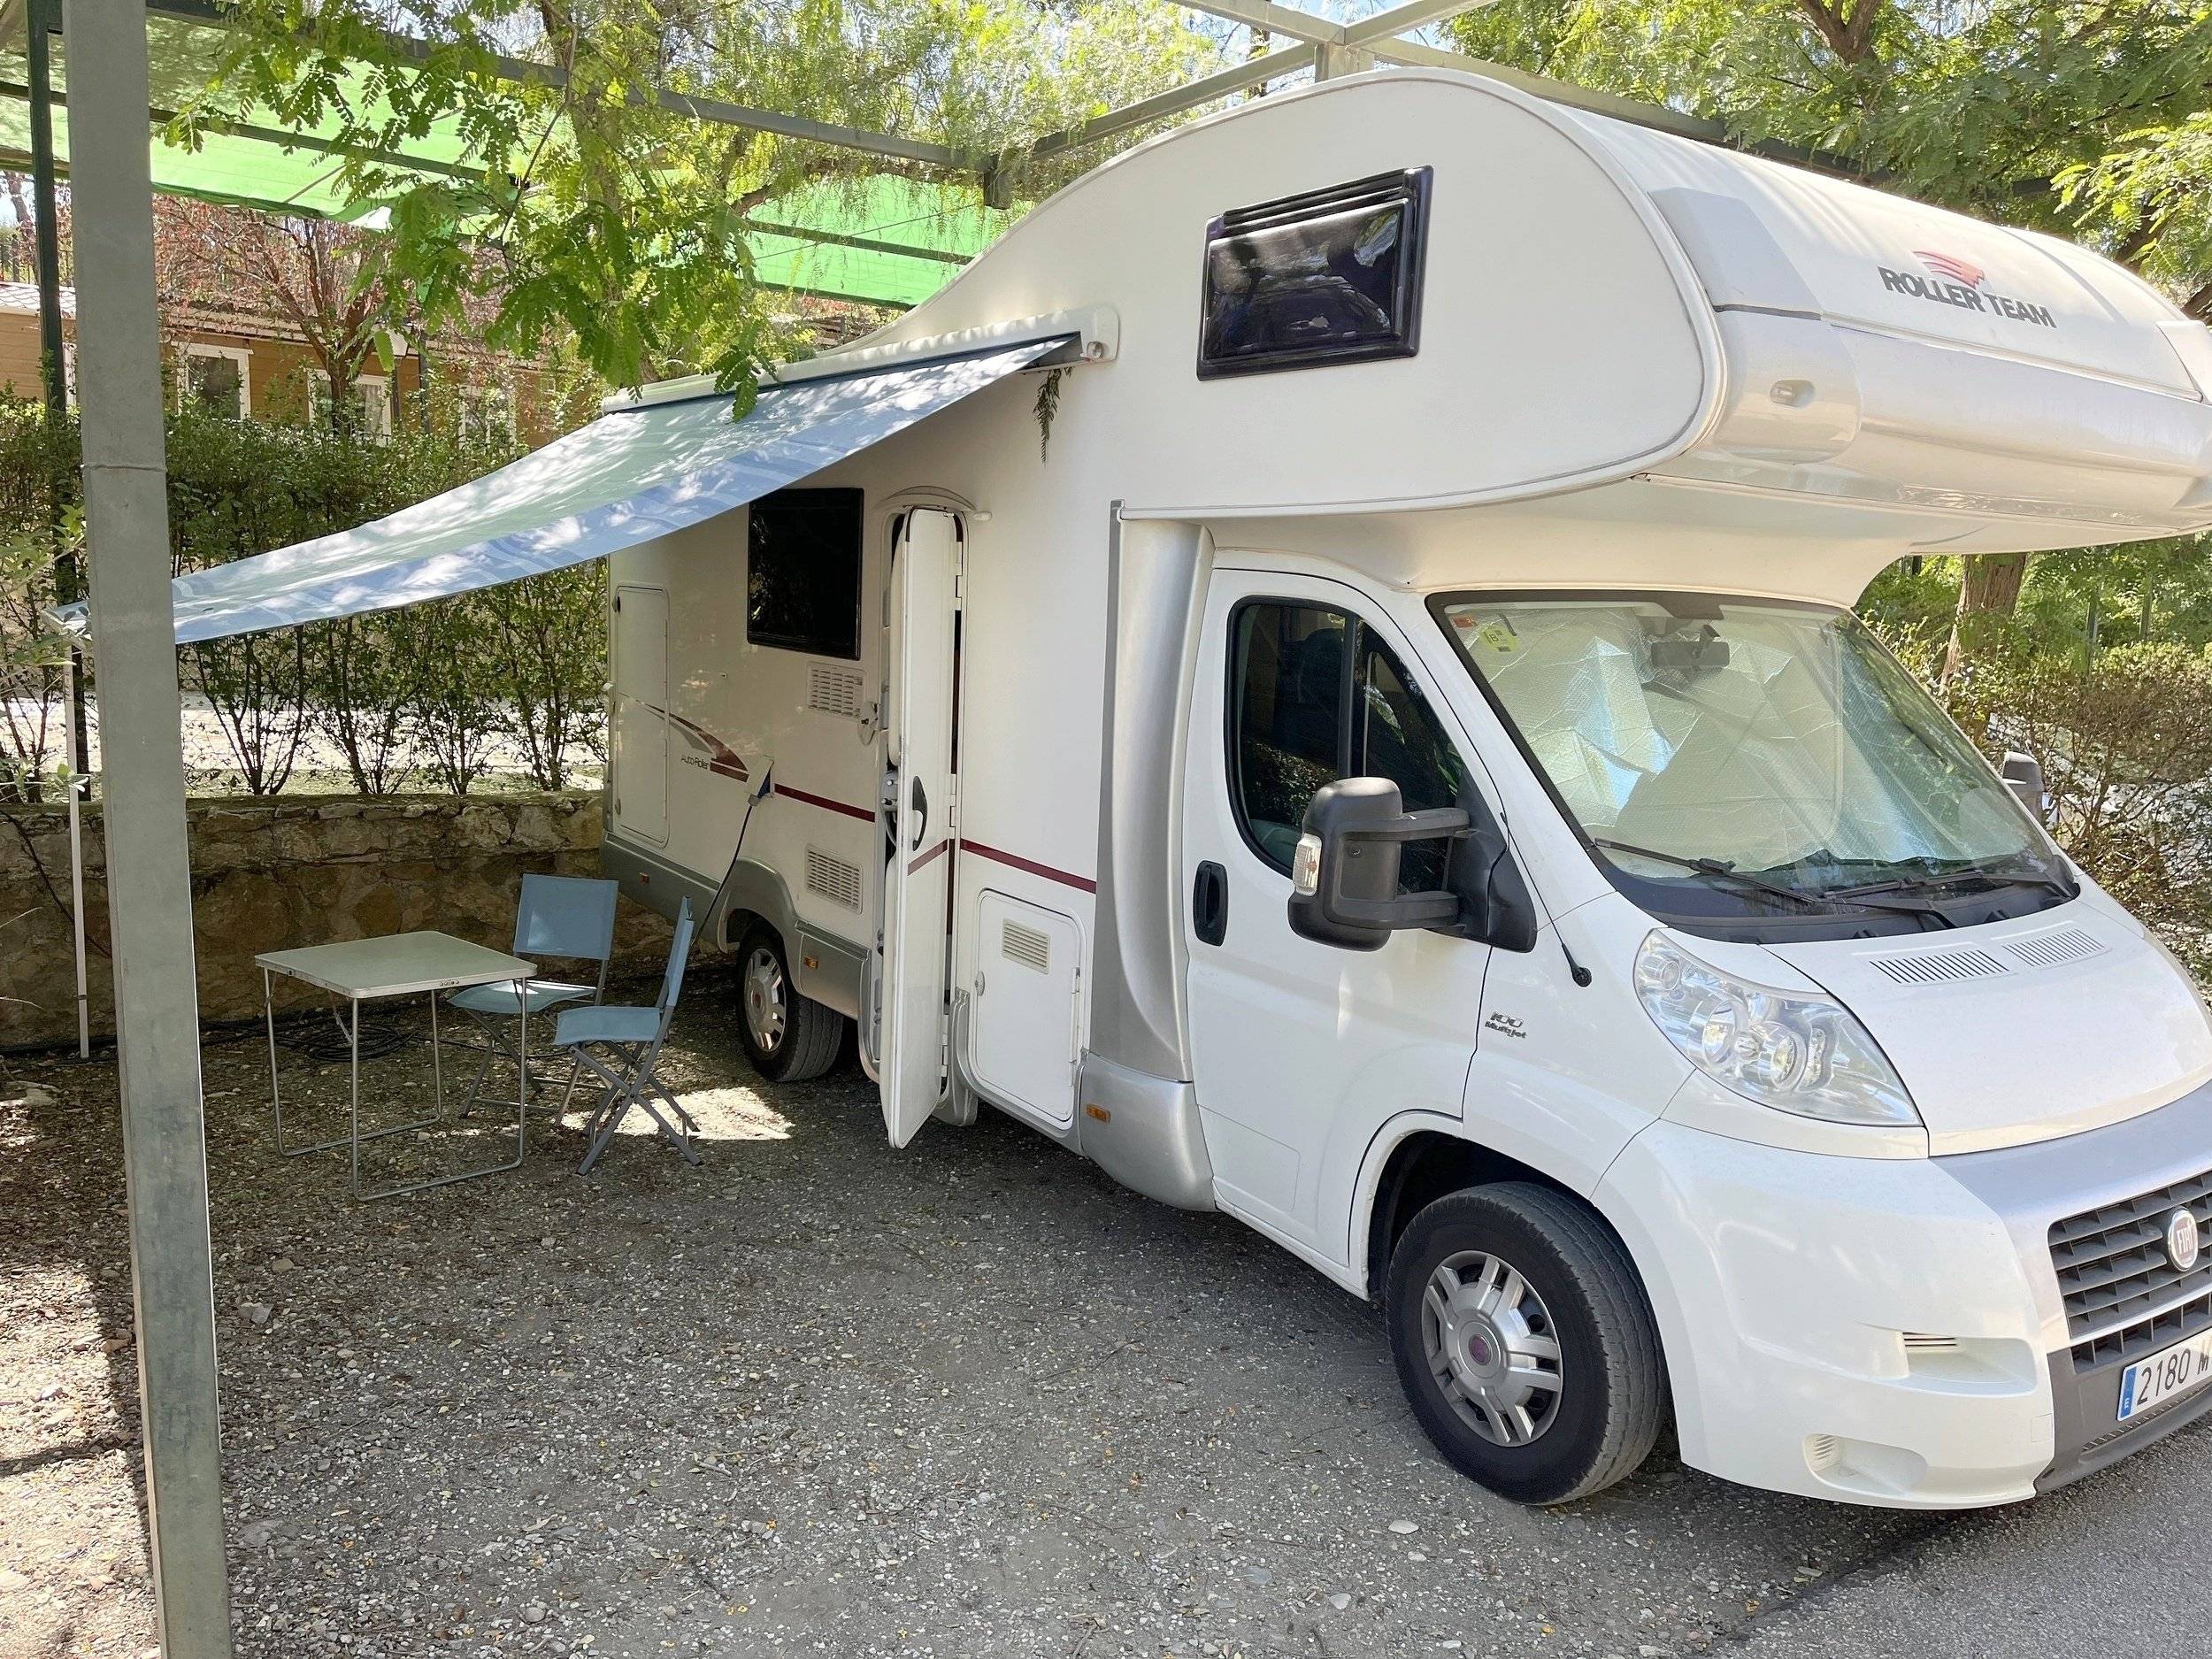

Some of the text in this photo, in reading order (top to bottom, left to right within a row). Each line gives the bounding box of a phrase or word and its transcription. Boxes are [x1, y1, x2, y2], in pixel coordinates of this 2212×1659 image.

[1877, 266, 2057, 328] ROLLER TEAM
[2176, 1225, 2195, 1255] FIAT
[2137, 1348, 2192, 1406] 2180
